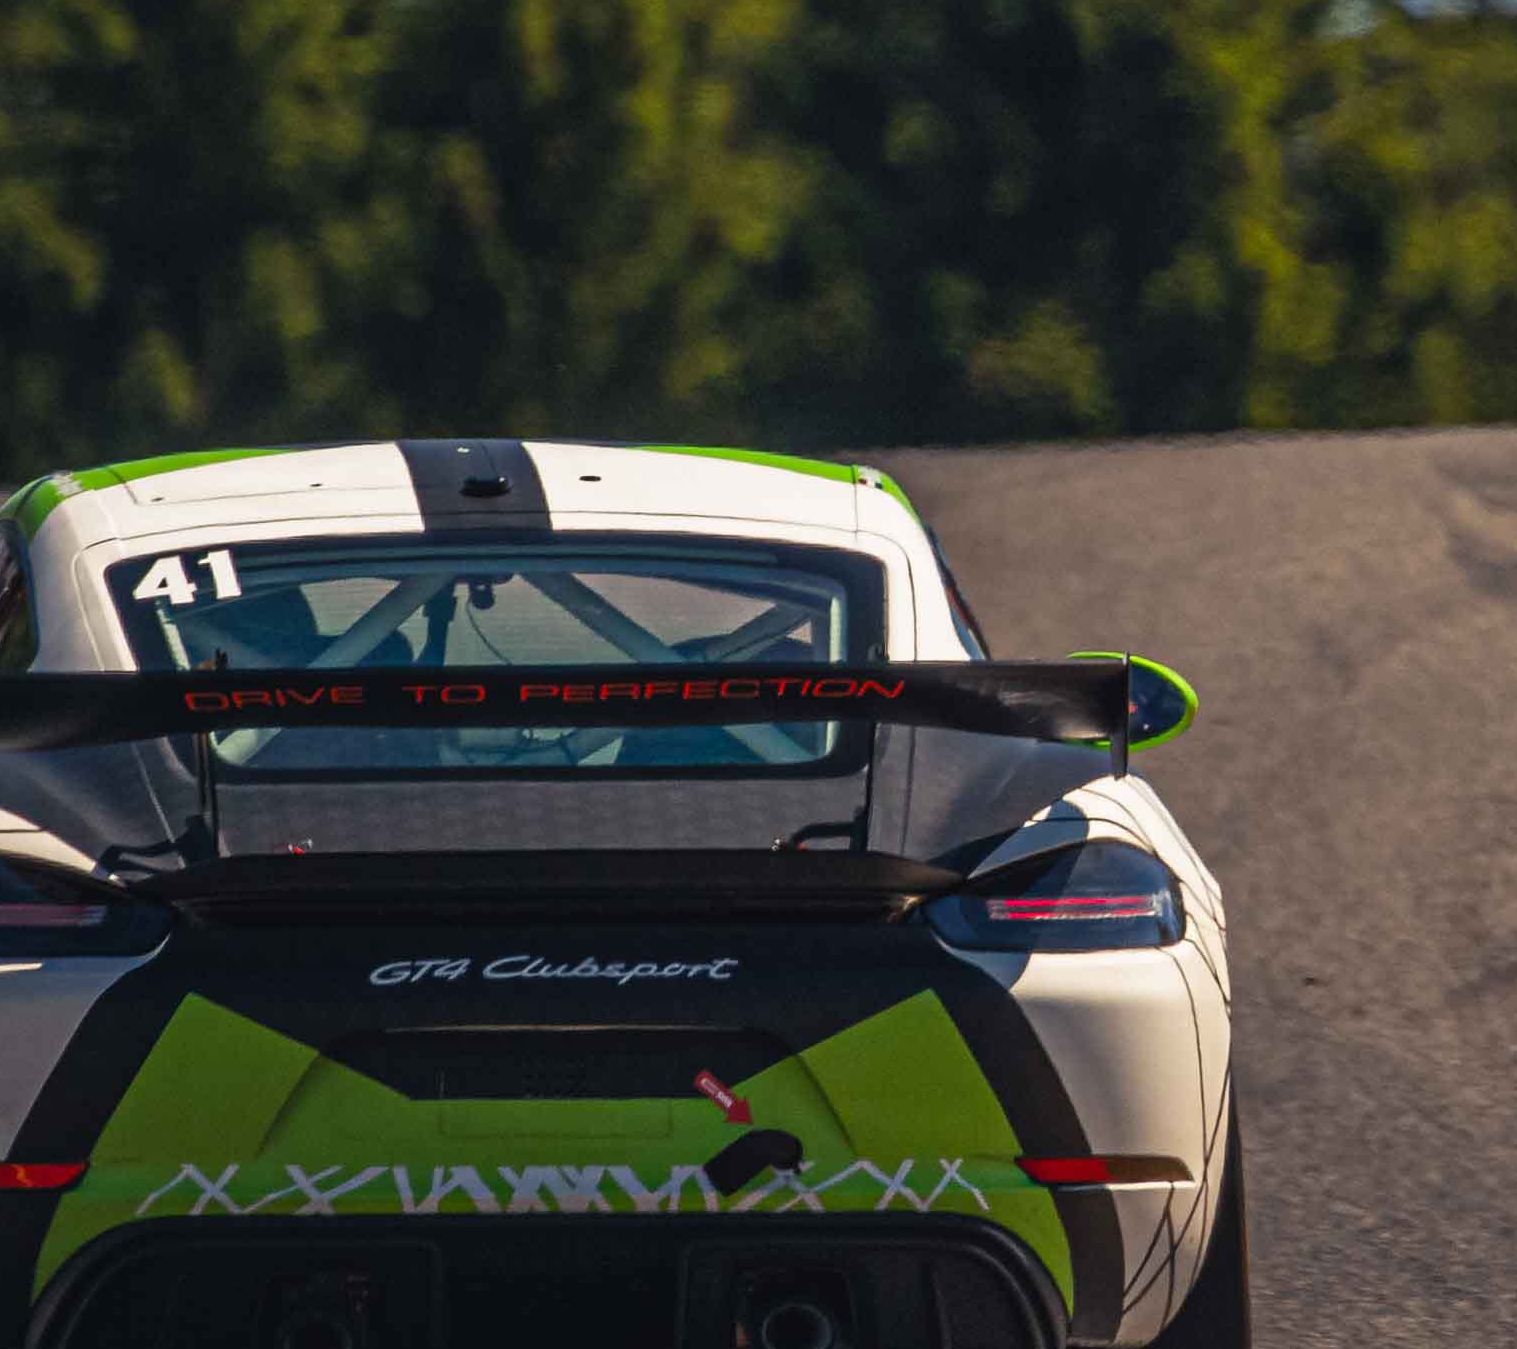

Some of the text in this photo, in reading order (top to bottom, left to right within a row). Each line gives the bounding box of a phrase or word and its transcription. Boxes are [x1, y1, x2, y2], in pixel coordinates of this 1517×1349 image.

[133, 549, 242, 604] 41
[184, 678, 904, 711] DRIVE TO PERFECTION
[369, 955, 738, 985] GT4 Clubsport
